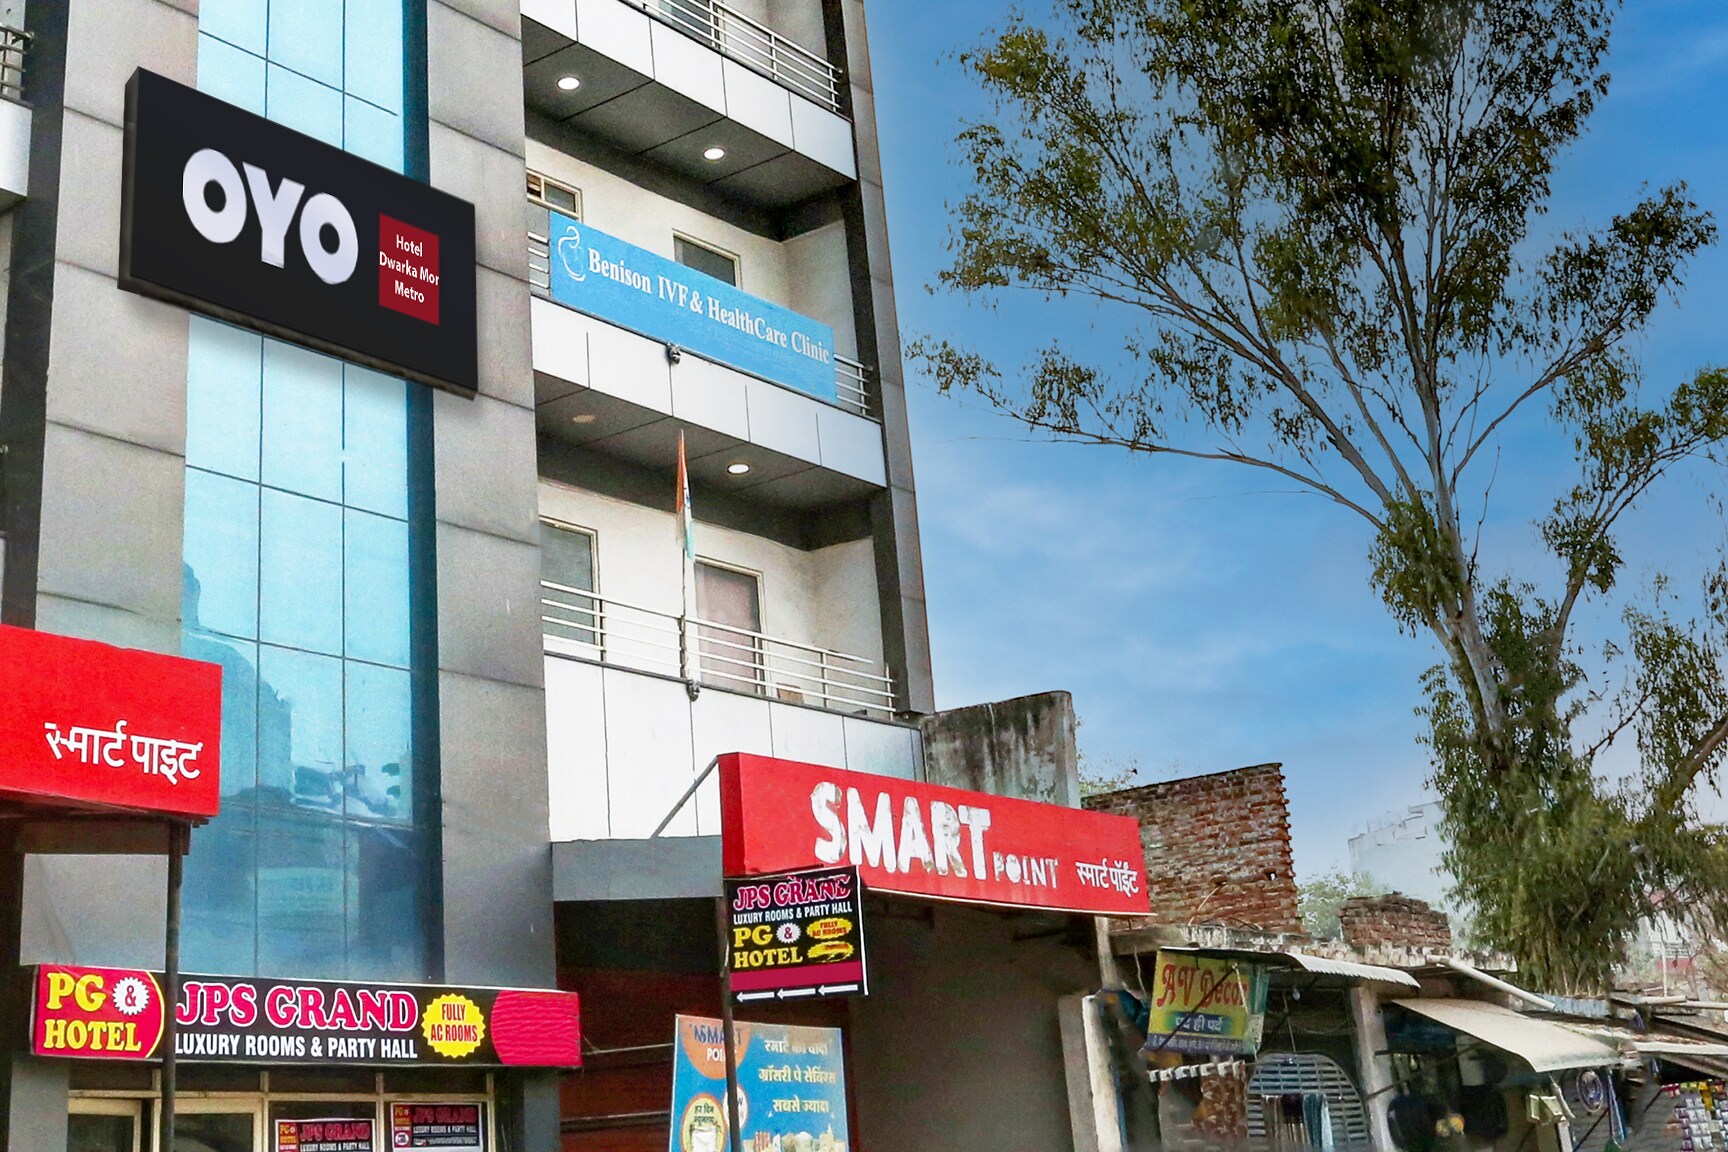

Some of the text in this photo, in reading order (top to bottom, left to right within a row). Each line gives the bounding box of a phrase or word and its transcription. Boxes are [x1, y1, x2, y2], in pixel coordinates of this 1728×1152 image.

[183, 148, 359, 285] OYO
[396, 233, 423, 257] Hotel
[378, 250, 440, 286] Dwarka Mor
[394, 280, 425, 303] Metro
[588, 247, 830, 364] Benison IVF & HealthCare Clinic
[810, 781, 1059, 889] SMART POINT
[1075, 858, 1109, 889] स्मार्ट
[733, 885, 771, 911] JPS
[733, 901, 852, 925] LUXURY ROOMS & PARTY HALL
[733, 925, 793, 947] PG &
[733, 946, 803, 968] HOTEL
[46, 972, 137, 1012] PG &
[175, 981, 419, 1031] JPS GRAND
[441, 1003, 466, 1021] FULLY
[43, 1019, 142, 1052] HOTEL
[174, 1033, 418, 1058] LUXURY ROOMS & PARTY HALL
[430, 1024, 478, 1042] AC ROOMS
[696, 1023, 743, 1046] SMAT
